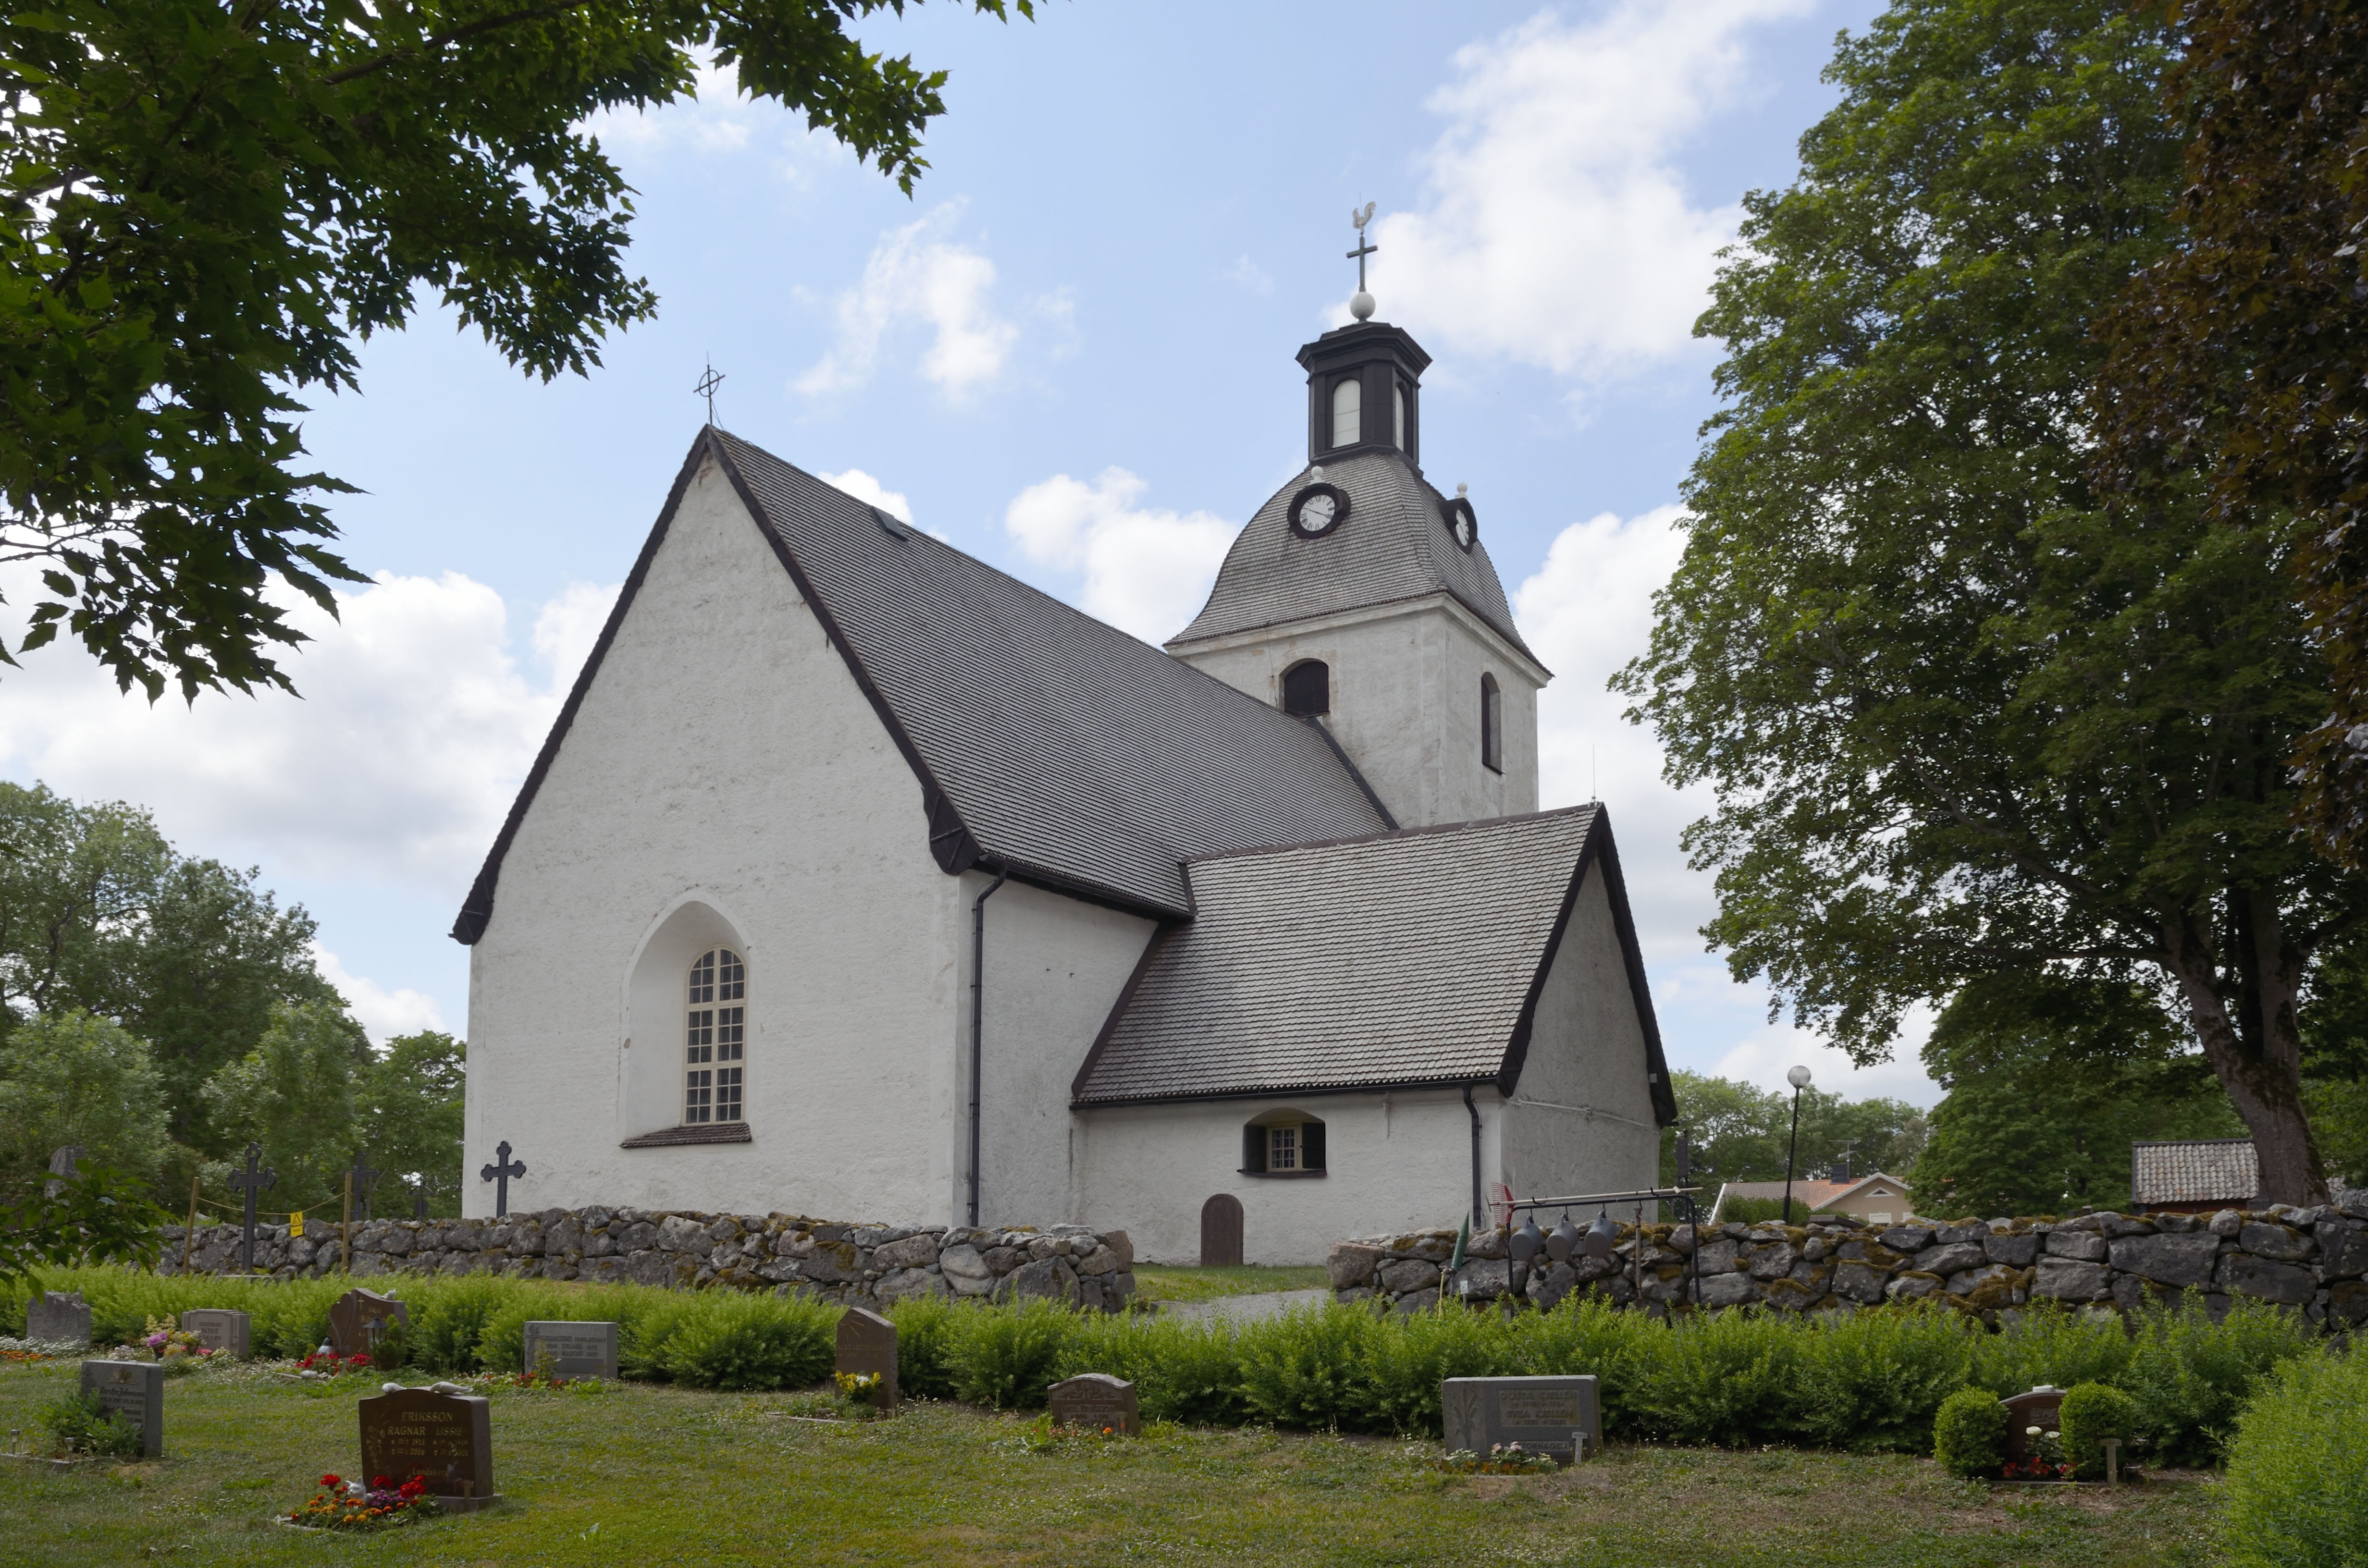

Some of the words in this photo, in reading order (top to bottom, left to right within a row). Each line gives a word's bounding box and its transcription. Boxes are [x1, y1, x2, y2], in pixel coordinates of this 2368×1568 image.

[402, 1412, 454, 1422] ERIKSSON
[387, 1426, 426, 1435] RAGNAR
[435, 1427, 464, 1436] LISSIE
